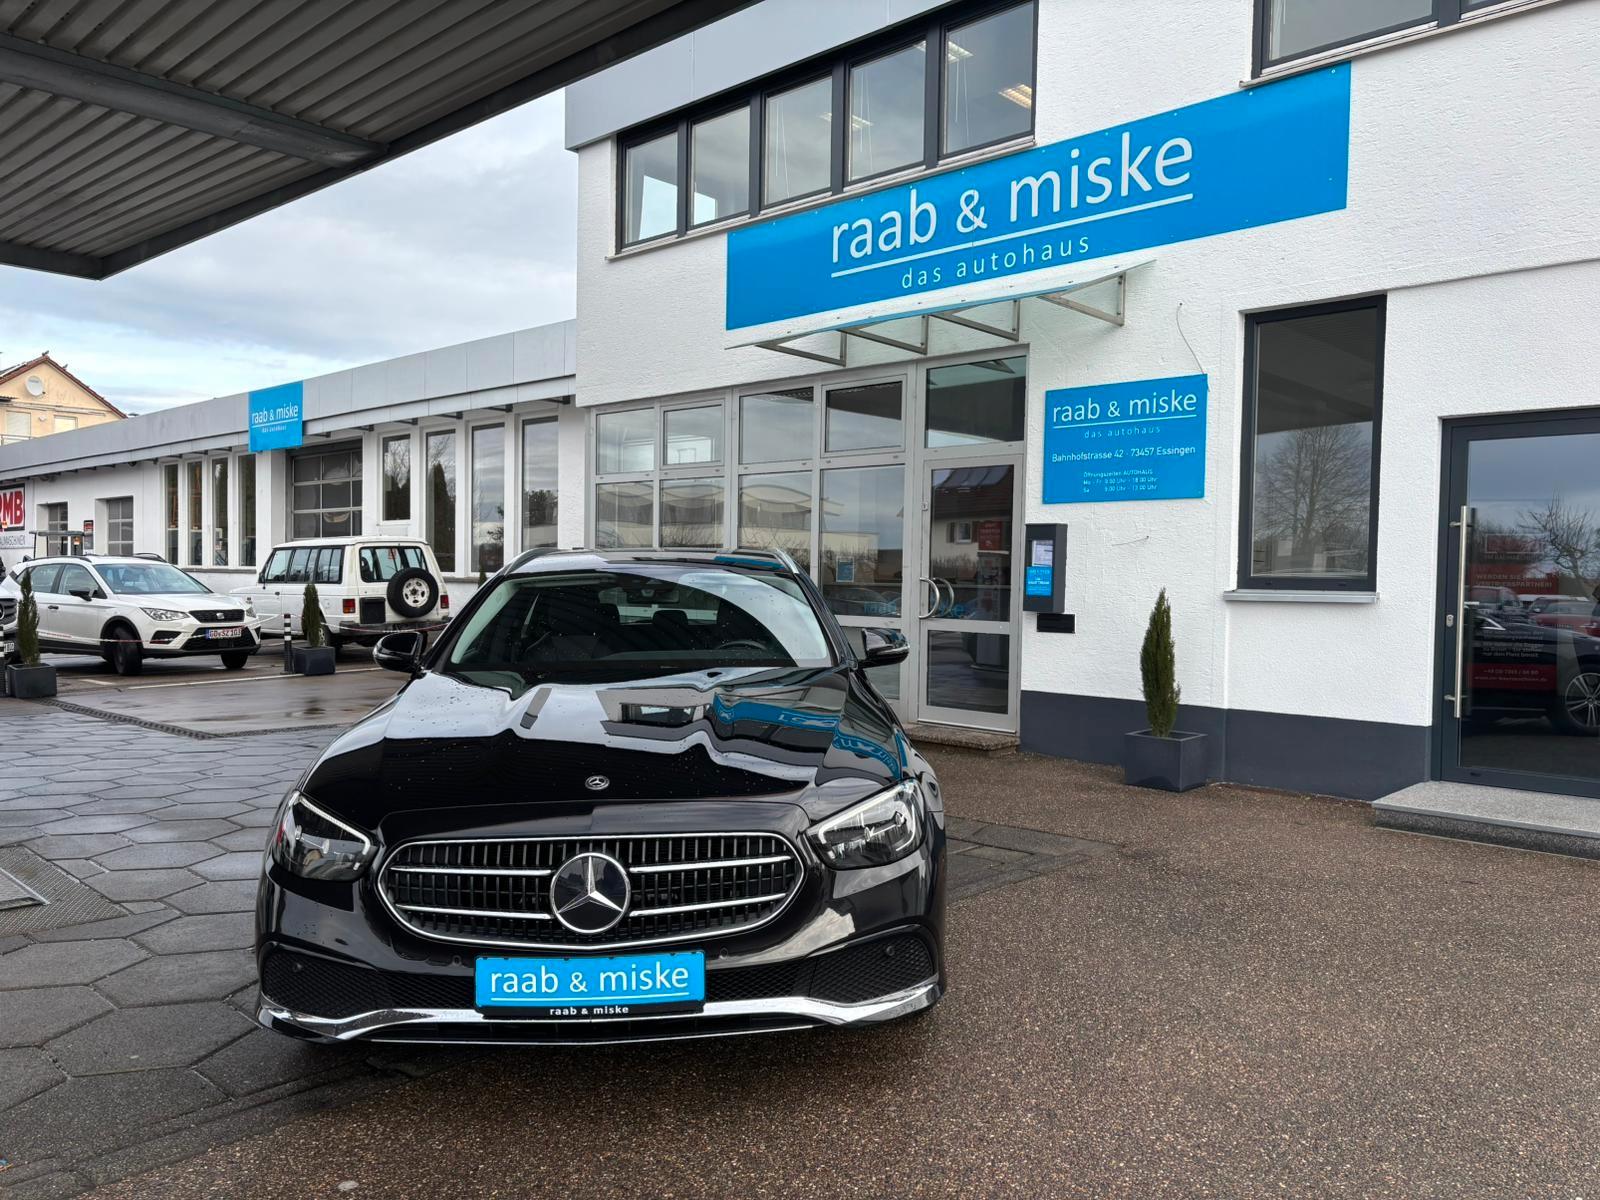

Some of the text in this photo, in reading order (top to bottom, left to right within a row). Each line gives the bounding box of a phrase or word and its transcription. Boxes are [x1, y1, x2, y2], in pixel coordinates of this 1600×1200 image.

[831, 131, 1193, 263] raab & miske
[901, 233, 1090, 290] das autohaus
[251, 401, 299, 424] raab & miske
[1053, 389, 1197, 423] raab & miske
[1084, 426, 1161, 439] das autohaus
[1052, 446, 1196, 463] Bahnhofstrasse 42 73457 Essingen
[1123, 468, 1153, 476] AUTOHAUS
[0, 491, 24, 525] MB
[491, 961, 689, 994] raab & miske
[550, 1006, 577, 1016] raab
[593, 1005, 629, 1015] miske
